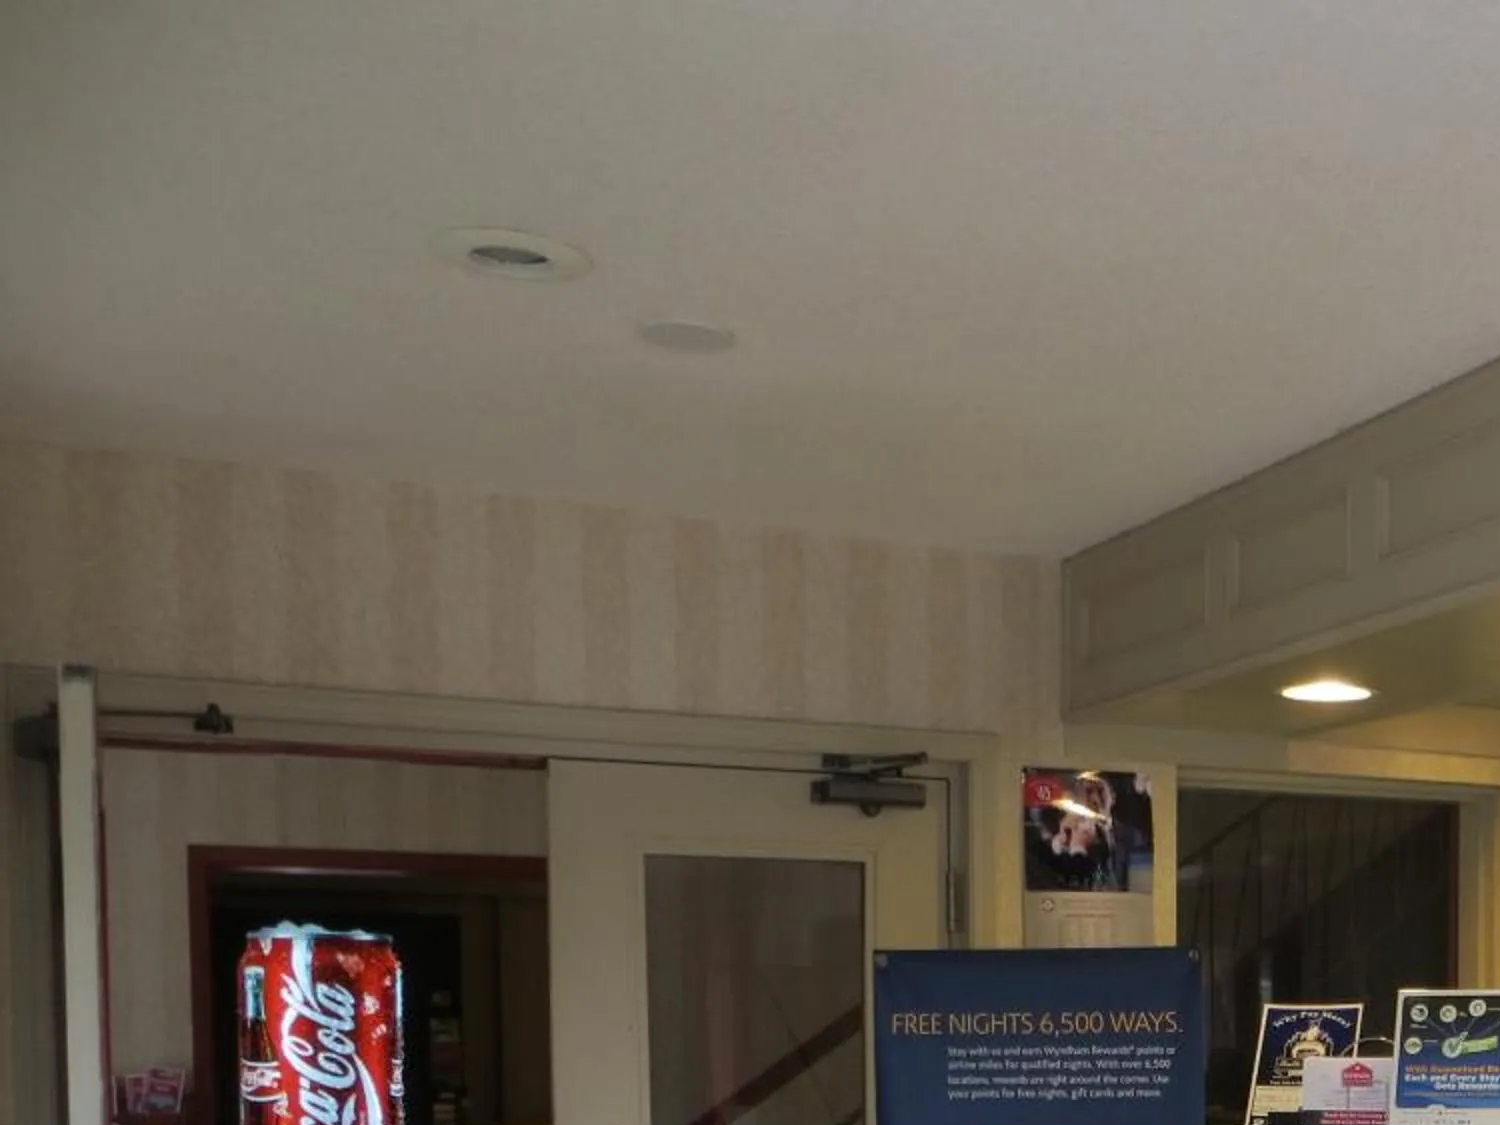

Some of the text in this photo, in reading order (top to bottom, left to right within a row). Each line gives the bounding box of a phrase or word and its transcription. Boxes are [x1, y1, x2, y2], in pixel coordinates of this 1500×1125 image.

[892, 1011, 1184, 1038] FREE NIGHTS 6,500 WAYS.
